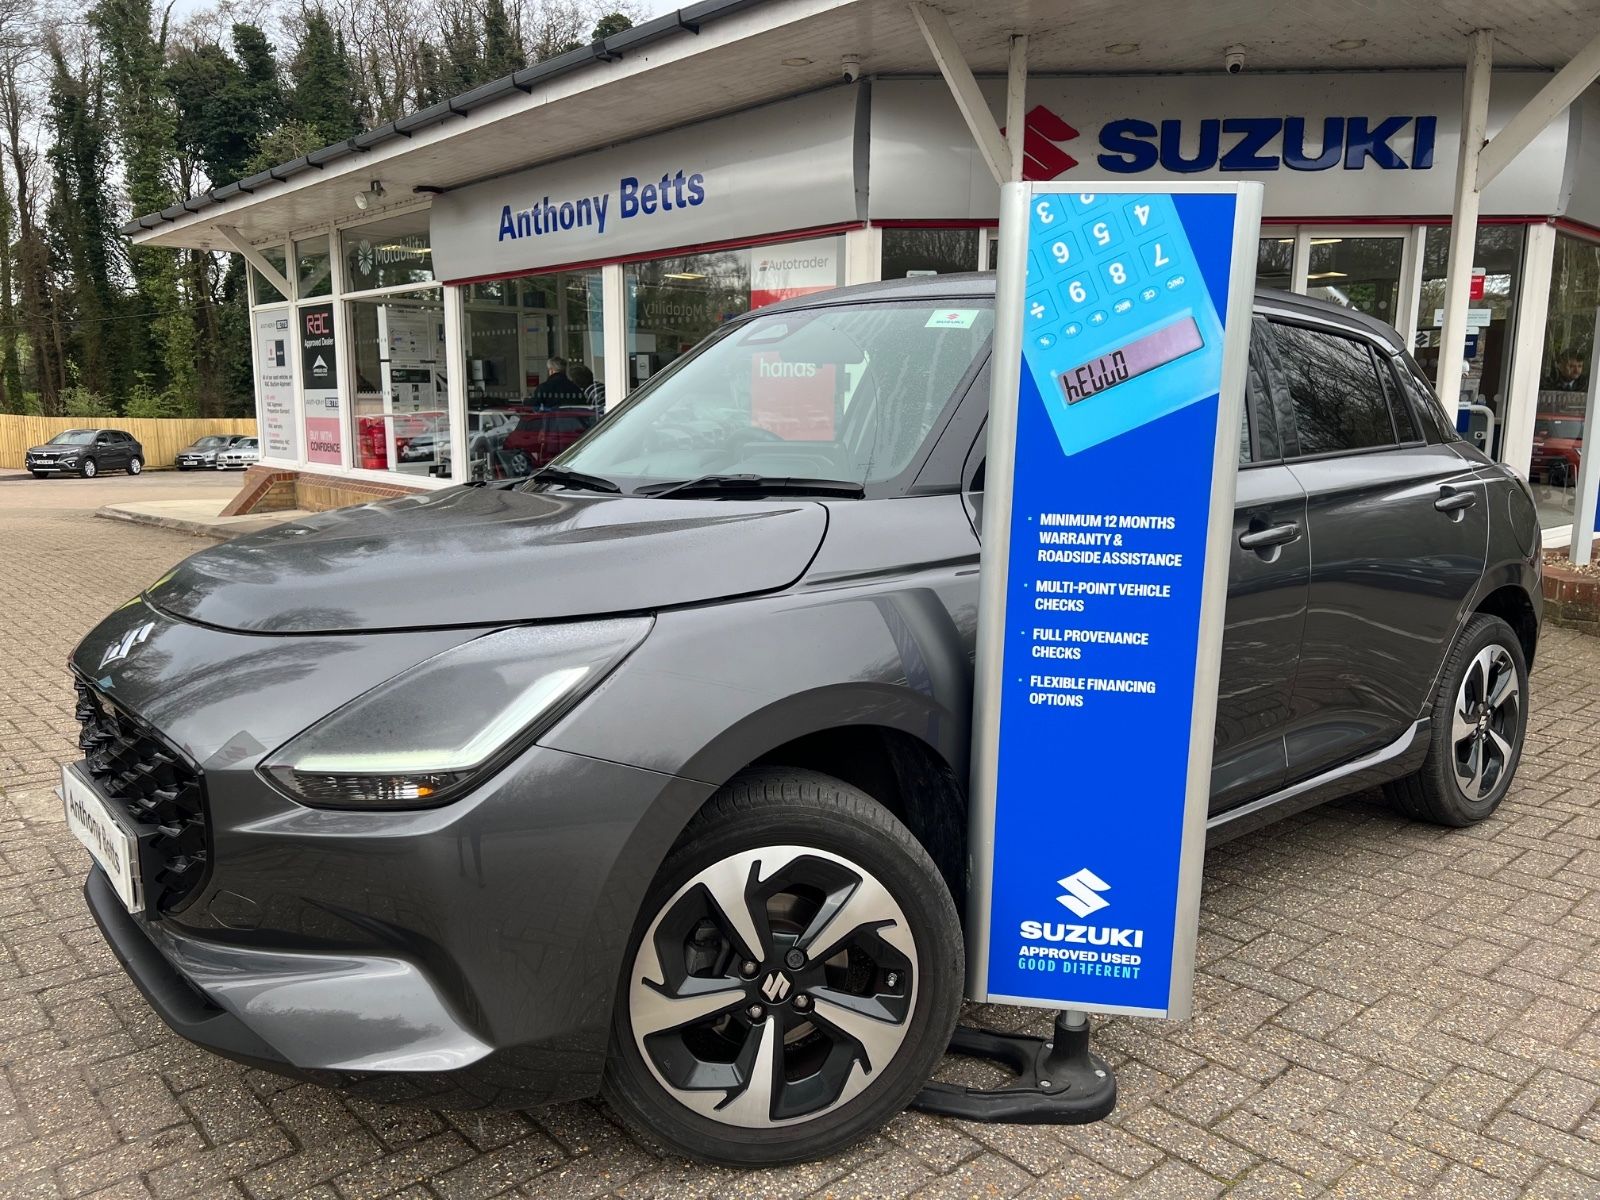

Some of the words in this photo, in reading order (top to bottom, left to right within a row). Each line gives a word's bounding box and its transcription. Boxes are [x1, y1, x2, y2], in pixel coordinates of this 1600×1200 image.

[1097, 116, 1437, 173] SUZUKI
[498, 194, 609, 242] Anthony
[620, 169, 705, 219] Betts
[1036, 202, 1054, 224] 3
[1133, 203, 1150, 226] 4
[1092, 222, 1111, 246] 5
[375, 236, 426, 265] Motability
[1052, 241, 1070, 264] 6
[1153, 243, 1169, 267] 7
[768, 256, 829, 271] Autotrader
[1108, 262, 1127, 285] 8
[1068, 281, 1087, 303] 9
[310, 441, 340, 453] CONFIDENCE
[1040, 513, 1101, 527] MINIMUM
[1103, 515, 1117, 528] 12
[1118, 516, 1175, 529] MONTHS
[1039, 531, 1112, 546] WARRANTY
[1112, 533, 1123, 546] &
[1038, 550, 1101, 564] ROADSIDE
[1102, 552, 1182, 567] ASSISTANCE
[1036, 580, 1117, 595] MULTI-POINT
[1118, 583, 1171, 598] VEHICLE
[1035, 598, 1084, 612] CHECKS
[1033, 628, 1062, 641] FULL
[1063, 630, 1149, 645] PROVENANCE
[1032, 645, 1081, 660] CHECKS
[1030, 675, 1085, 690] FLEXIBLE
[1087, 678, 1156, 694] FINANCING
[1029, 693, 1084, 707] OPTIONS
[69, 789, 102, 851] Anthony
[101, 825, 121, 875] Betts
[1020, 920, 1144, 949] SUZUKI
[1019, 945, 1099, 963] APPROVED
[1100, 952, 1142, 966] USED
[1018, 957, 1056, 973] GOOD
[1063, 961, 1141, 980] DIFFERENT
